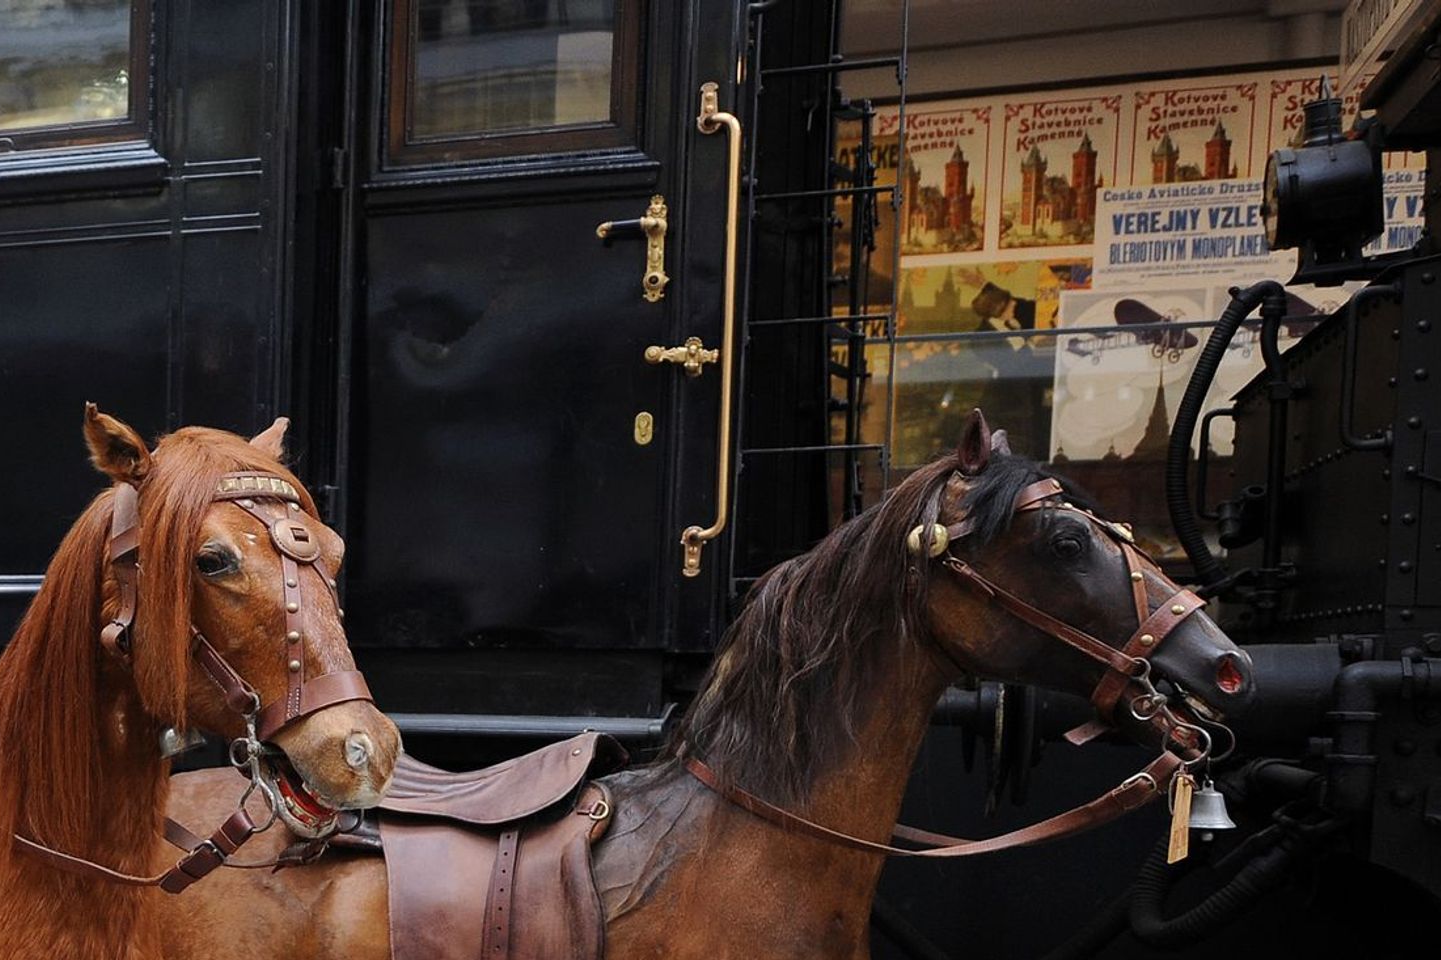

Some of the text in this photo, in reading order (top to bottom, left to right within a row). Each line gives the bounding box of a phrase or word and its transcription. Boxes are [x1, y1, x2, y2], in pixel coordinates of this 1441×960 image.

[1164, 90, 1227, 107] Kotvové
[1033, 102, 1093, 118] Kotvové
[1148, 103, 1239, 122] Stavebnice
[1018, 116, 1104, 133] Stavebnice
[1146, 117, 1217, 141] Kamenné
[1016, 128, 1083, 152] Kamenné
[1208, 204, 1259, 230] VZLE
